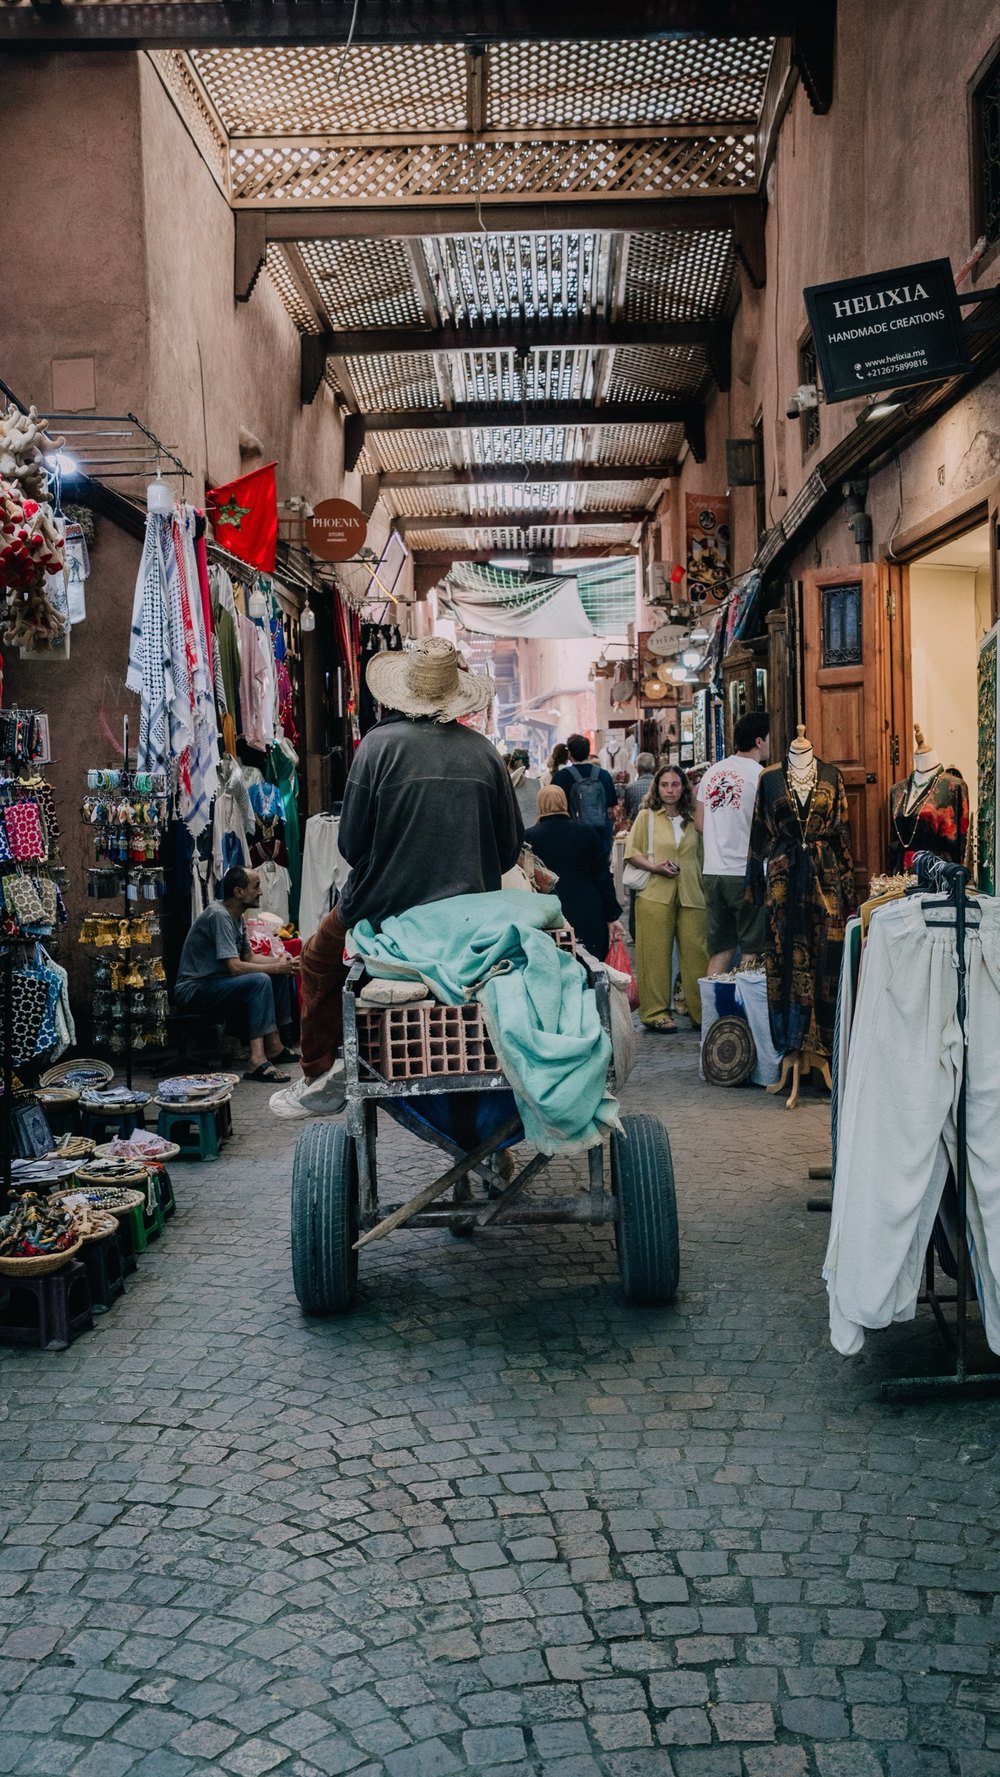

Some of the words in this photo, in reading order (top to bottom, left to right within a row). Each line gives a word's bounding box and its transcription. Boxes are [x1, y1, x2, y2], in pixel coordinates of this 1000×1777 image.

[832, 283, 930, 318] HELIXIA
[828, 322, 888, 344] HANDMADE
[889, 309, 945, 330] CREATIONS
[864, 349, 926, 368] www.helixia.ma
[866, 358, 928, 378] +212675899816
[312, 518, 360, 528] PHOENIX
